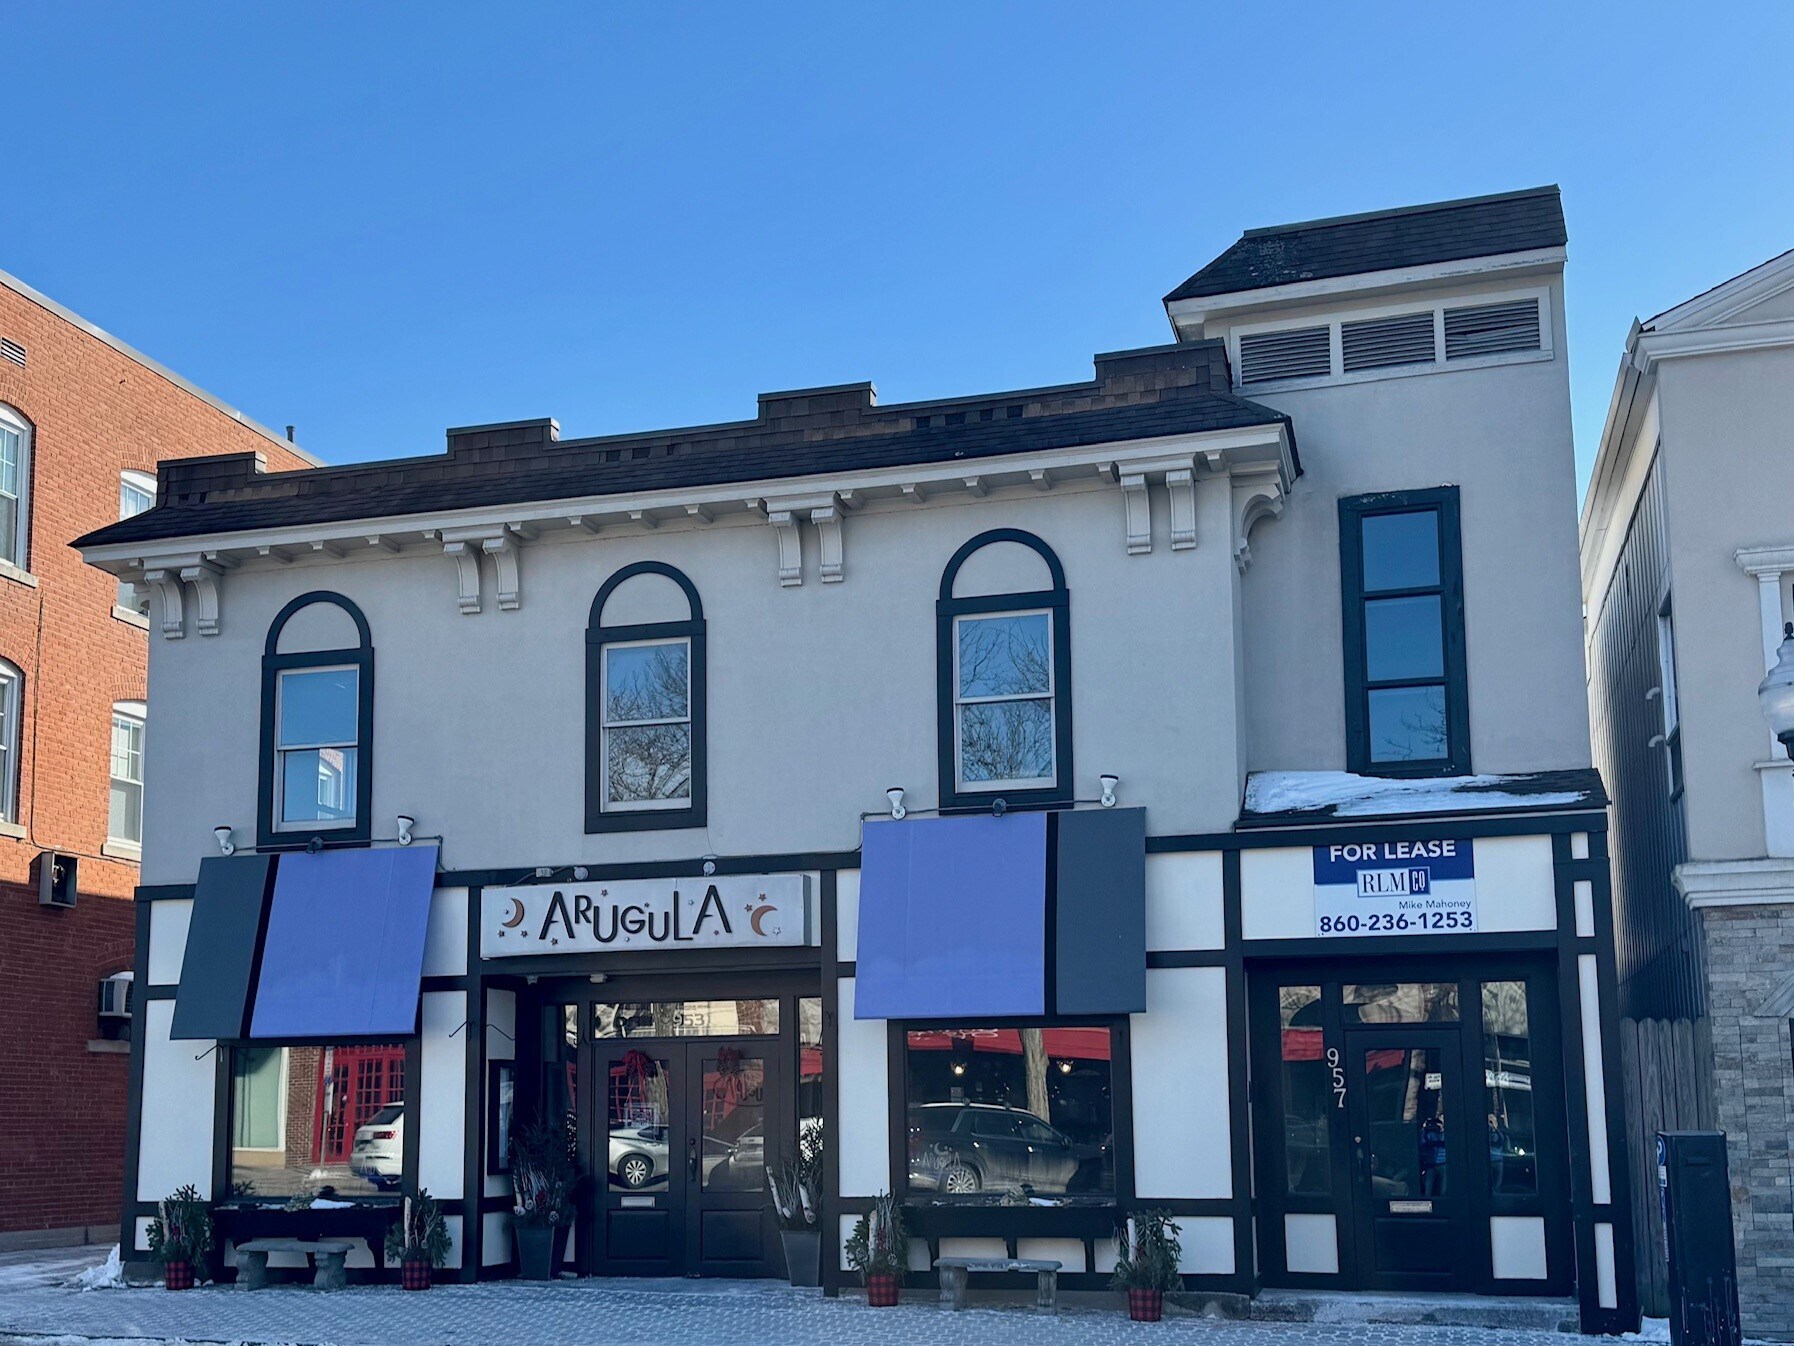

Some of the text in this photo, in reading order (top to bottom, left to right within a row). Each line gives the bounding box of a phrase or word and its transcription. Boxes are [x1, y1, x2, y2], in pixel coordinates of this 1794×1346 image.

[1330, 839, 1456, 863] FOR LEASE
[1361, 872, 1407, 893] RLM
[538, 884, 733, 943] ARUGULA
[1399, 899, 1472, 910] Mike Mahoney
[1320, 911, 1473, 933] 860-236-1253
[673, 1011, 705, 1026] 953
[1326, 1047, 1347, 1108] 957
